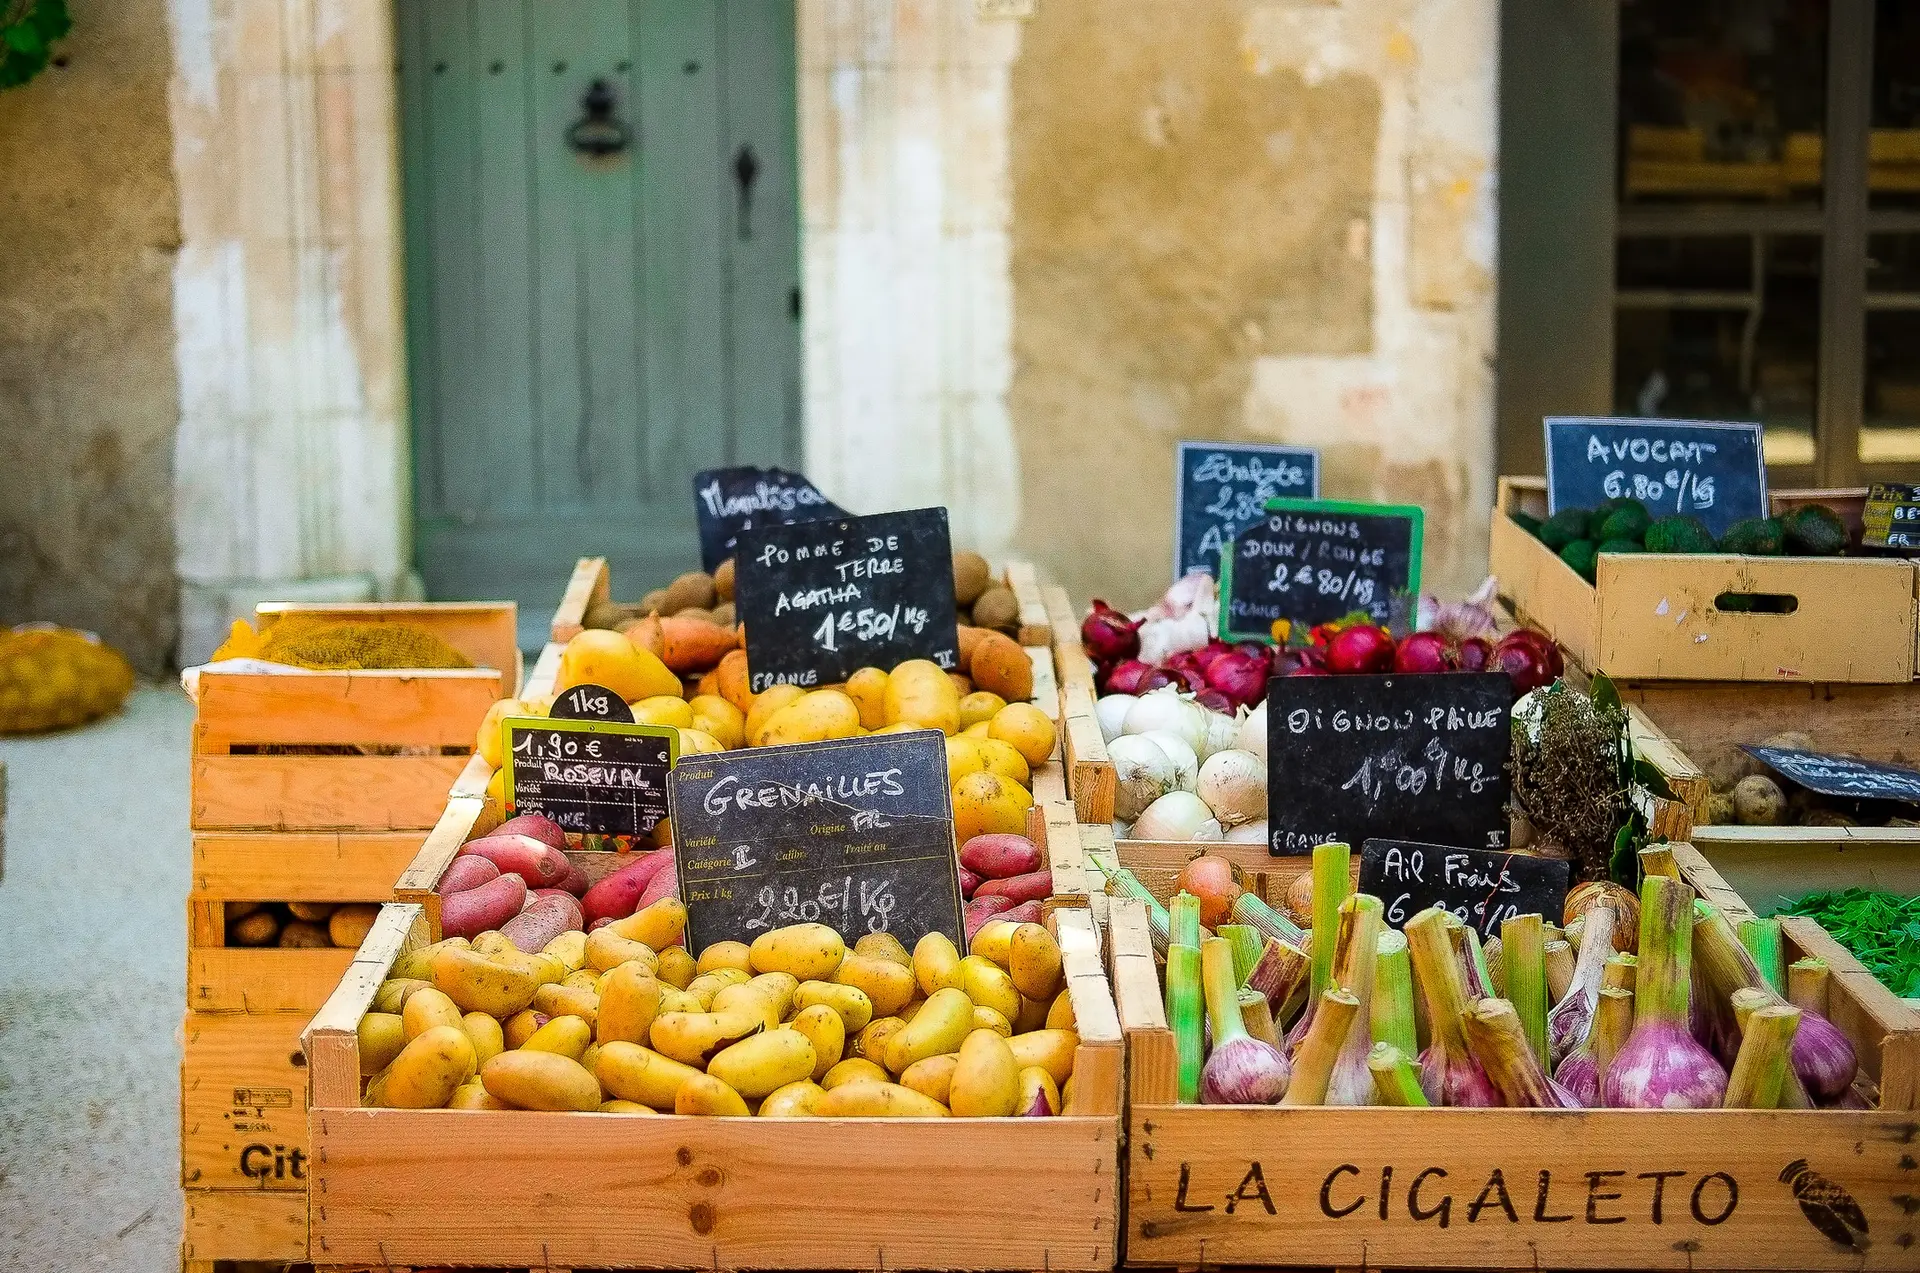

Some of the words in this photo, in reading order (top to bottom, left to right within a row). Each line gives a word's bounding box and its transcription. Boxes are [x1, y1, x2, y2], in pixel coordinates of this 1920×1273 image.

[1587, 434, 1717, 465] AVOCAT
[756, 540, 844, 567] POMME
[866, 535, 899, 553] DE
[1242, 539, 1295, 558] DOUX
[834, 557, 904, 582] TERRE
[775, 583, 862, 617] AGATHA
[752, 669, 817, 692] FRANCE
[569, 689, 609, 715] 1kg
[514, 758, 542, 769] Produit
[679, 769, 714, 781] Produit
[516, 799, 544, 810] Origine
[810, 824, 846, 836] Origine
[685, 836, 717, 848] Variété
[843, 843, 871, 854] Traité
[874, 842, 887, 852] au
[687, 858, 732, 870] Catégorie
[1384, 848, 1424, 883] Ail
[1445, 853, 1520, 892] Frais
[690, 890, 710, 901] Prix
[714, 888, 719, 899] 1
[721, 888, 733, 899] kg
[1174, 1161, 1277, 1217] LA
[1318, 1162, 1740, 1228] CIGALETO
